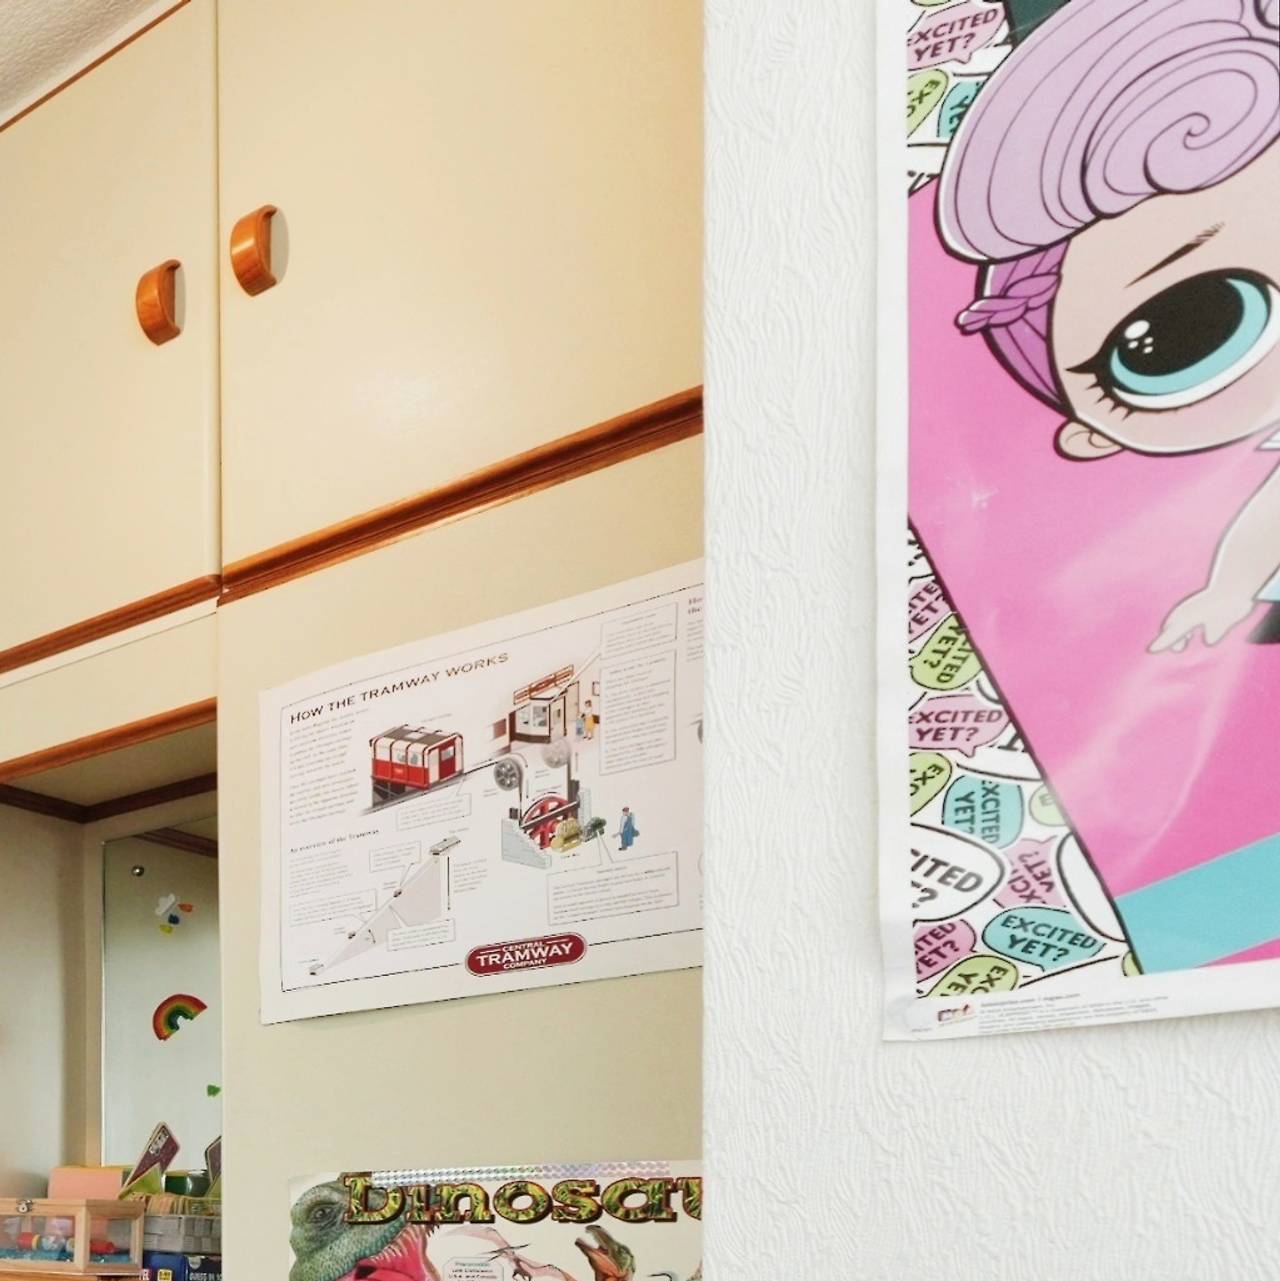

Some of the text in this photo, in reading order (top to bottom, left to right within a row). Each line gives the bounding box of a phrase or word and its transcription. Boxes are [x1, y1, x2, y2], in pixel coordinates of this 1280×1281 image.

[907, 8, 999, 46] XCITED
[914, 33, 976, 61] YET?
[290, 652, 509, 724] HOW THE TRAMWAY WORKS
[908, 710, 1003, 724] XCITED
[916, 726, 979, 742] YET?
[911, 853, 983, 893] ITED
[1001, 914, 1098, 950] EXCITED
[476, 942, 573, 967] TRAMWAY
[502, 941, 545, 952] CENTRAL
[1009, 934, 1070, 962] YET?
[503, 958, 548, 969] COMPANY
[341, 1172, 702, 1224] Dinosa
